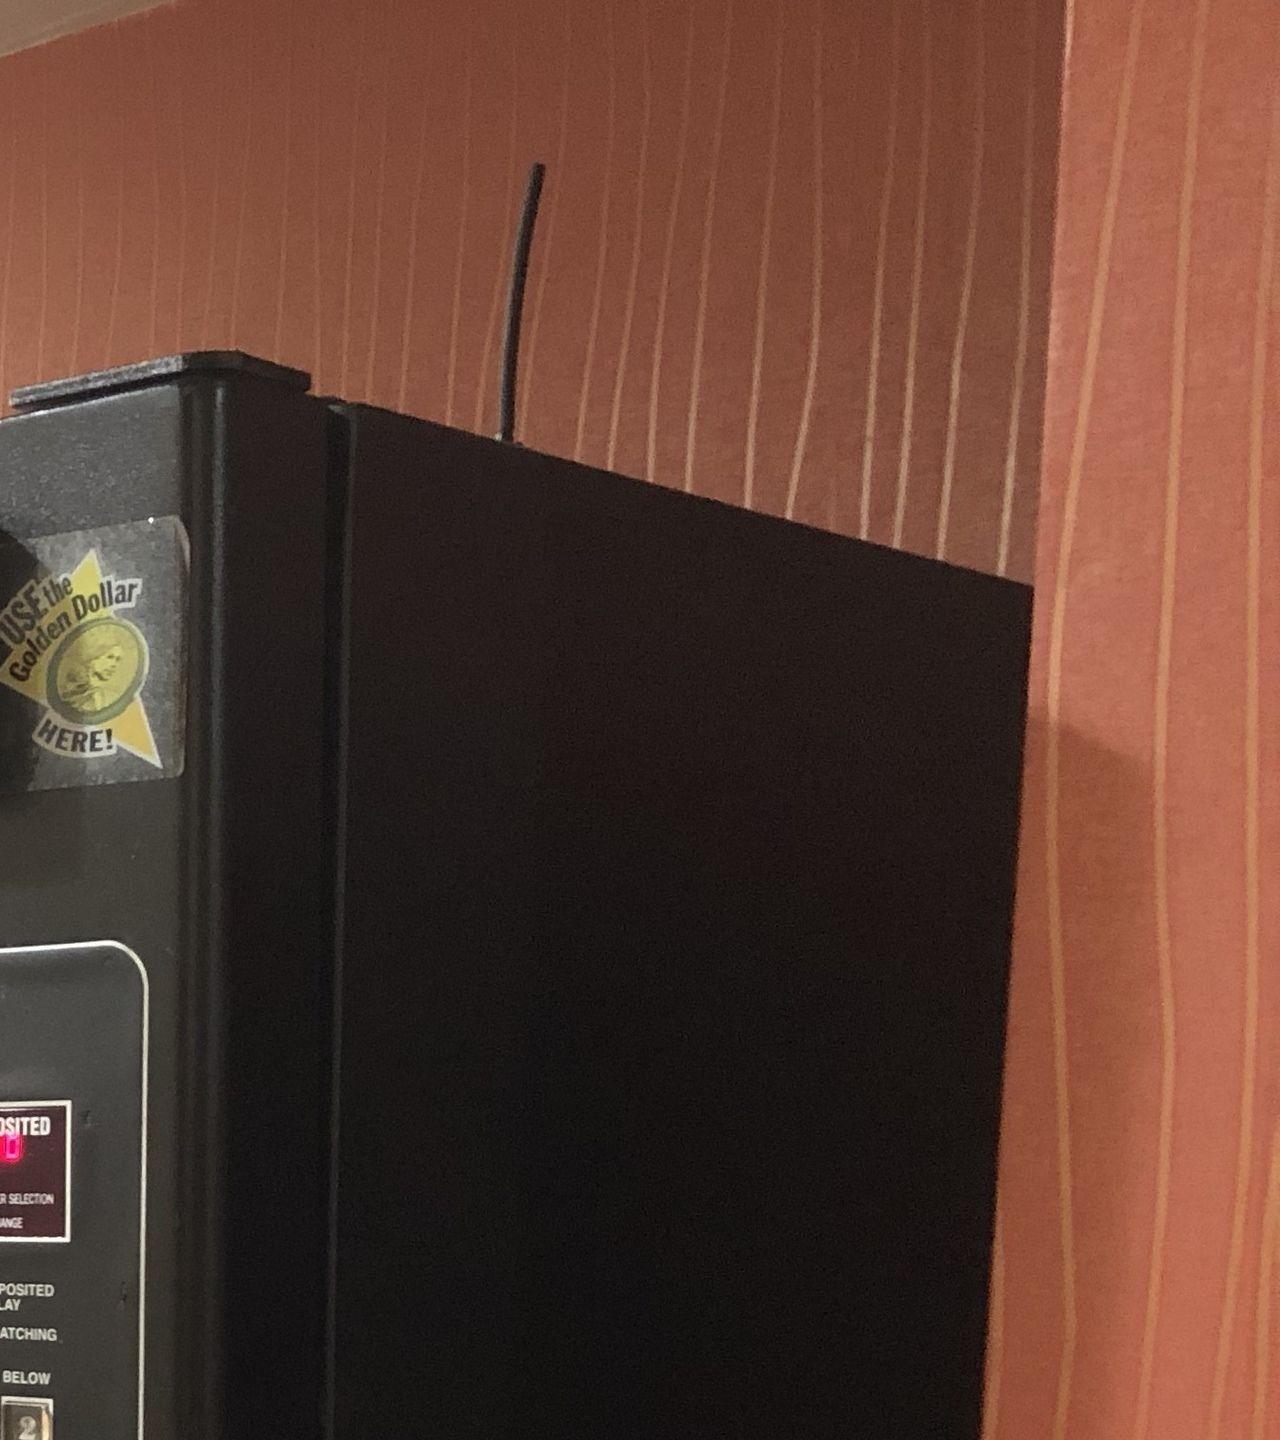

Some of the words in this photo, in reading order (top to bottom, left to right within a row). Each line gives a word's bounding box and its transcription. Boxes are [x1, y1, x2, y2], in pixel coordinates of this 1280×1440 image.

[43, 574, 73, 608] the
[9, 611, 72, 682] Golden
[71, 580, 138, 620] Dollar
[38, 719, 113, 753] HERE!
[9, 1192, 54, 1205] SELECTION
[2, 1370, 52, 1385] BELOW
[19, 1416, 37, 1440] 2
